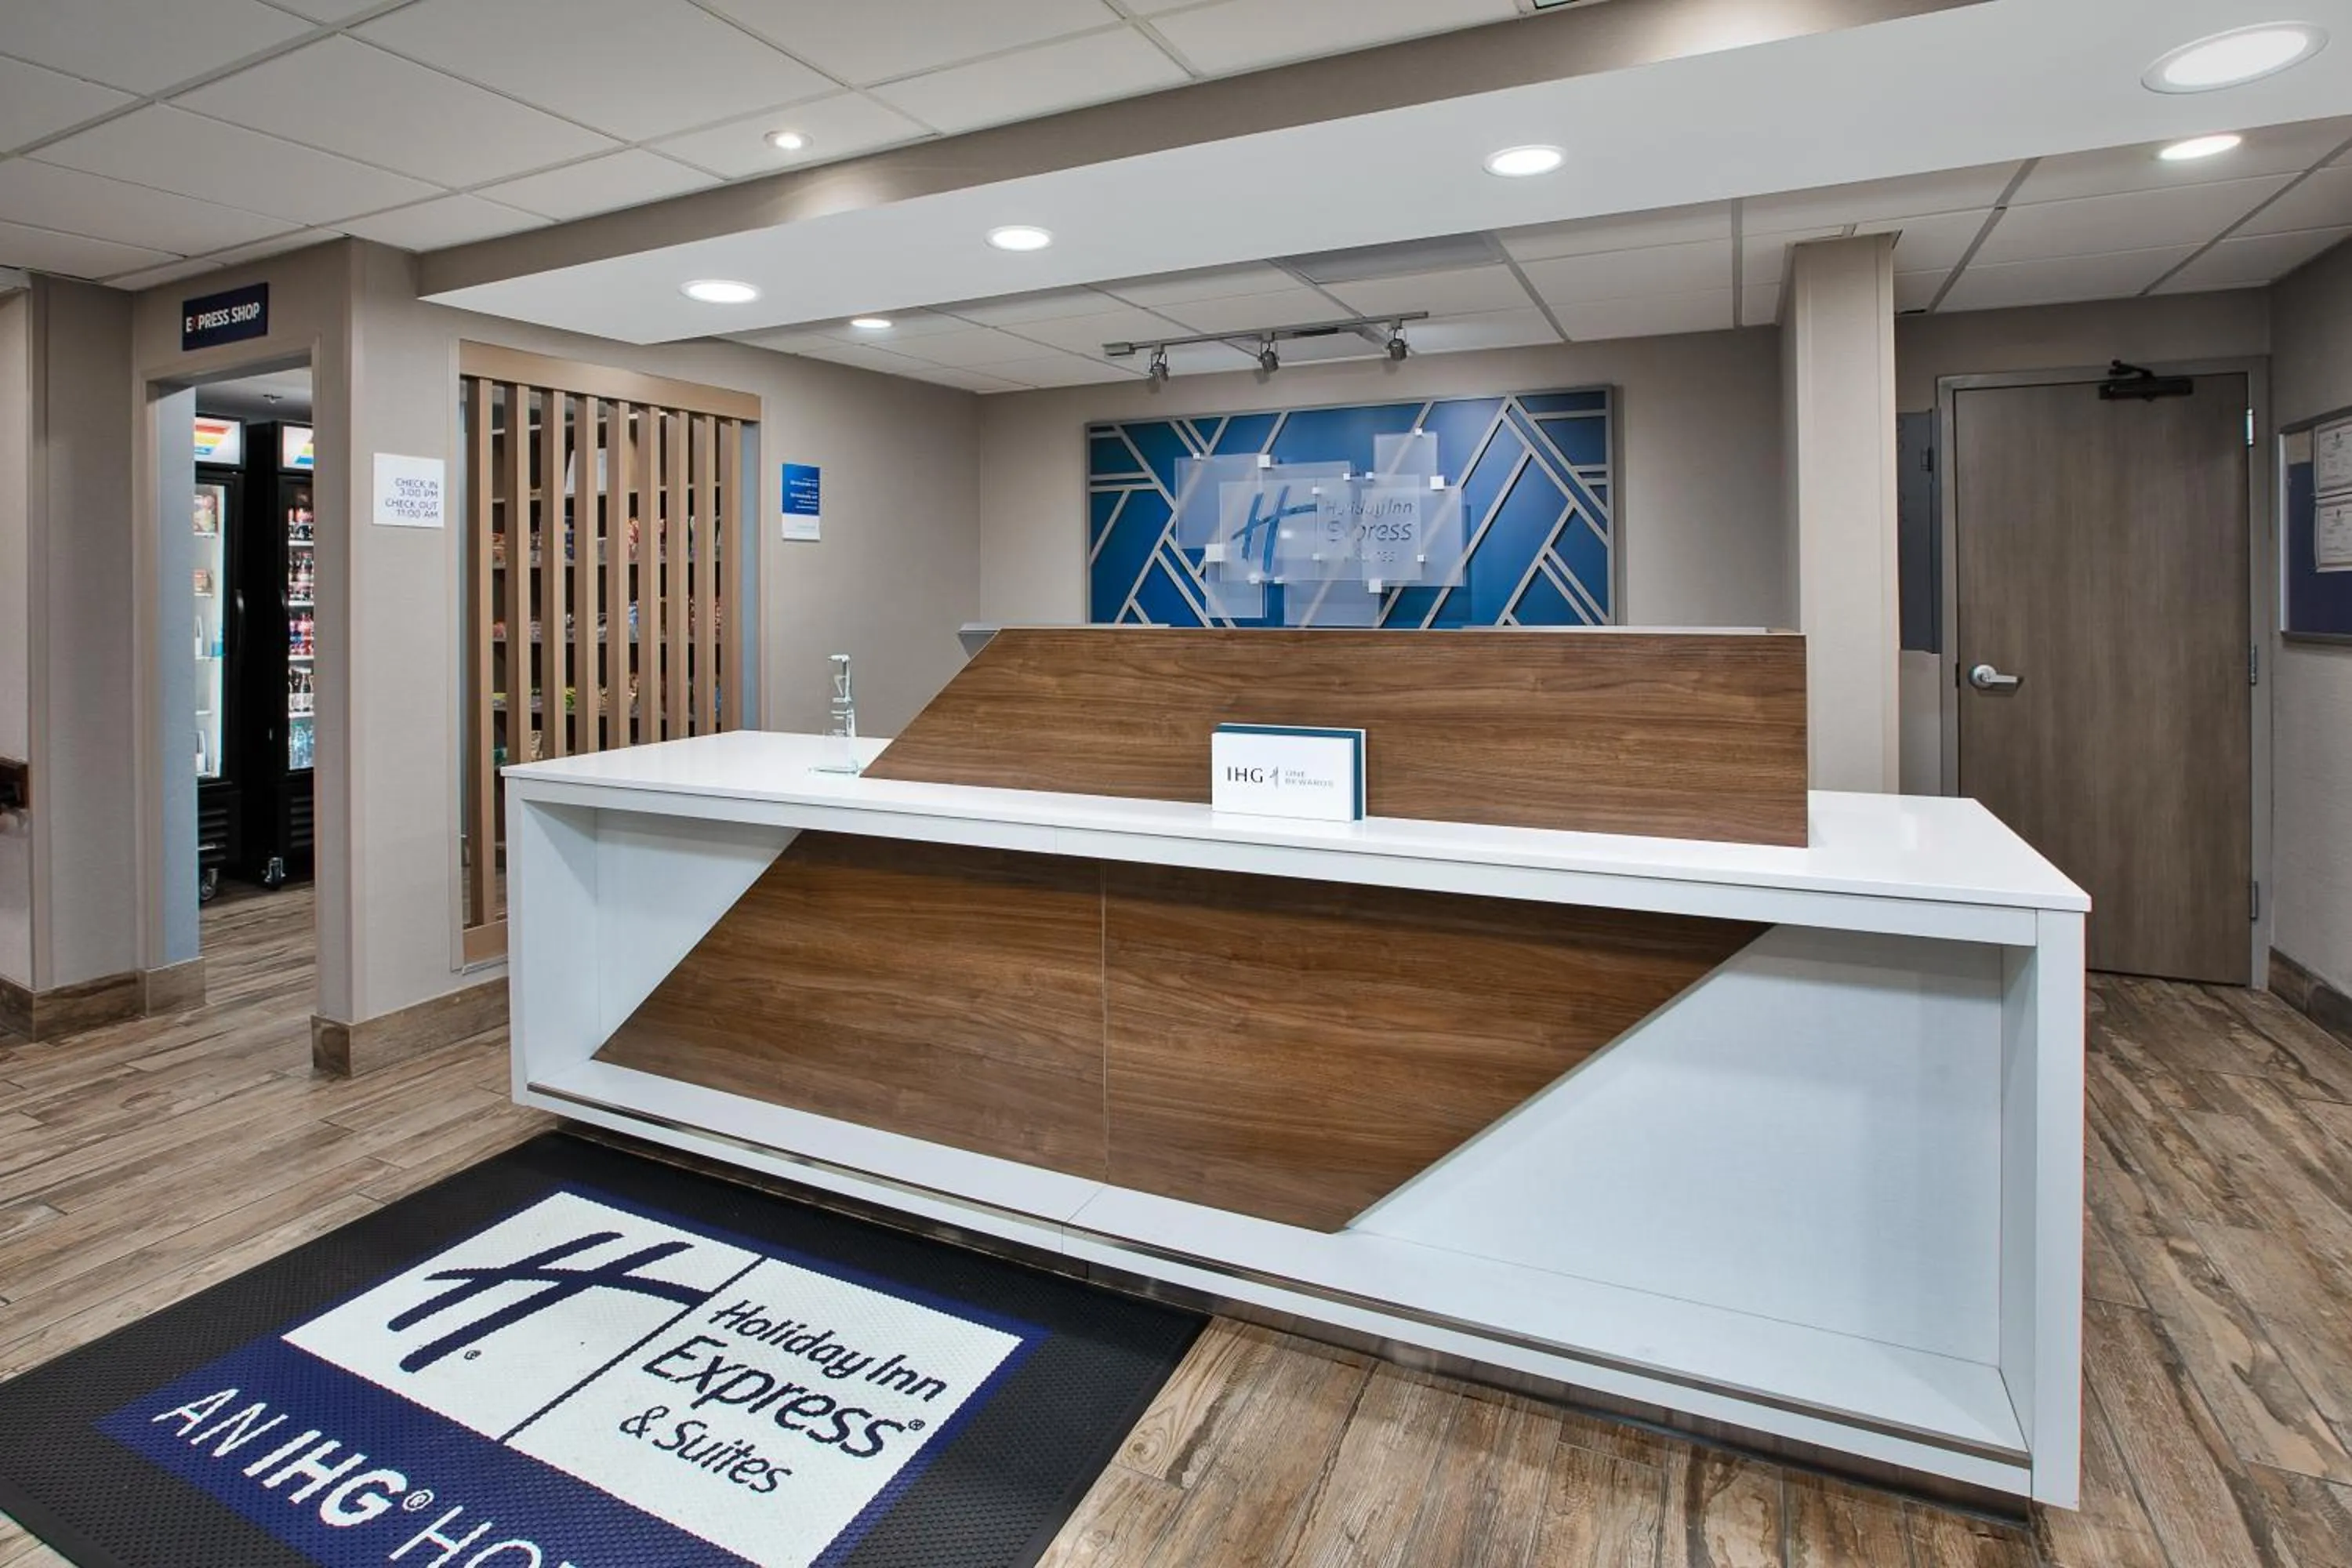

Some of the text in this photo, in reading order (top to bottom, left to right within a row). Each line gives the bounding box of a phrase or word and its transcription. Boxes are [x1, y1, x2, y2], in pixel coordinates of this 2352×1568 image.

[231, 302, 260, 324] SHOP
[395, 477, 438, 489] CHECK IN
[424, 488, 438, 498] PM
[385, 498, 438, 510] CHECK OUT
[1387, 498, 1412, 514] Inn
[424, 510, 438, 518] AM
[1327, 520, 1413, 542] Epress
[1227, 766, 1263, 783] IHG
[708, 1299, 947, 1402] Holiday Inn
[152, 1388, 289, 1457] AN
[619, 1405, 793, 1493] & Suites
